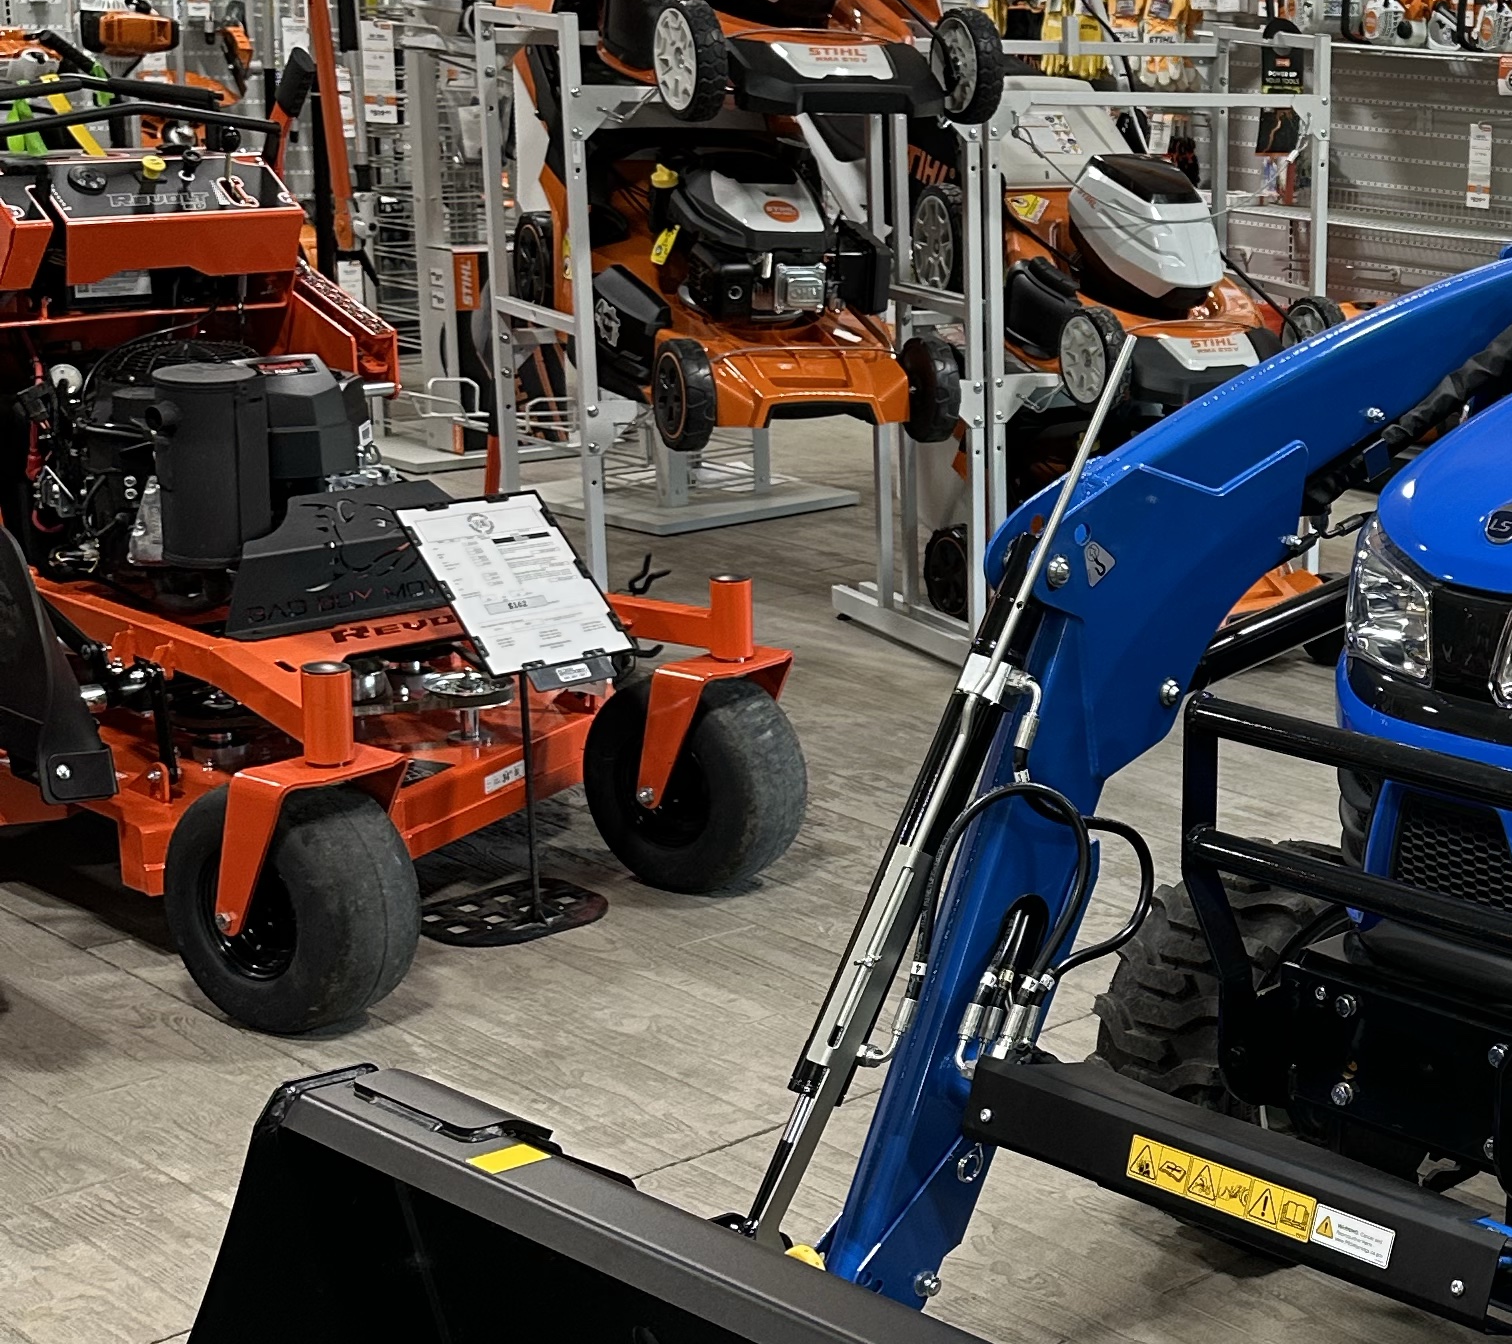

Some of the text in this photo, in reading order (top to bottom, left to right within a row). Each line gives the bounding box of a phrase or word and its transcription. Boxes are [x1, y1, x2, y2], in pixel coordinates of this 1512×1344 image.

[808, 47, 867, 57] STIHL
[460, 258, 475, 306] STIHL
[1190, 338, 1237, 348] STIHL
